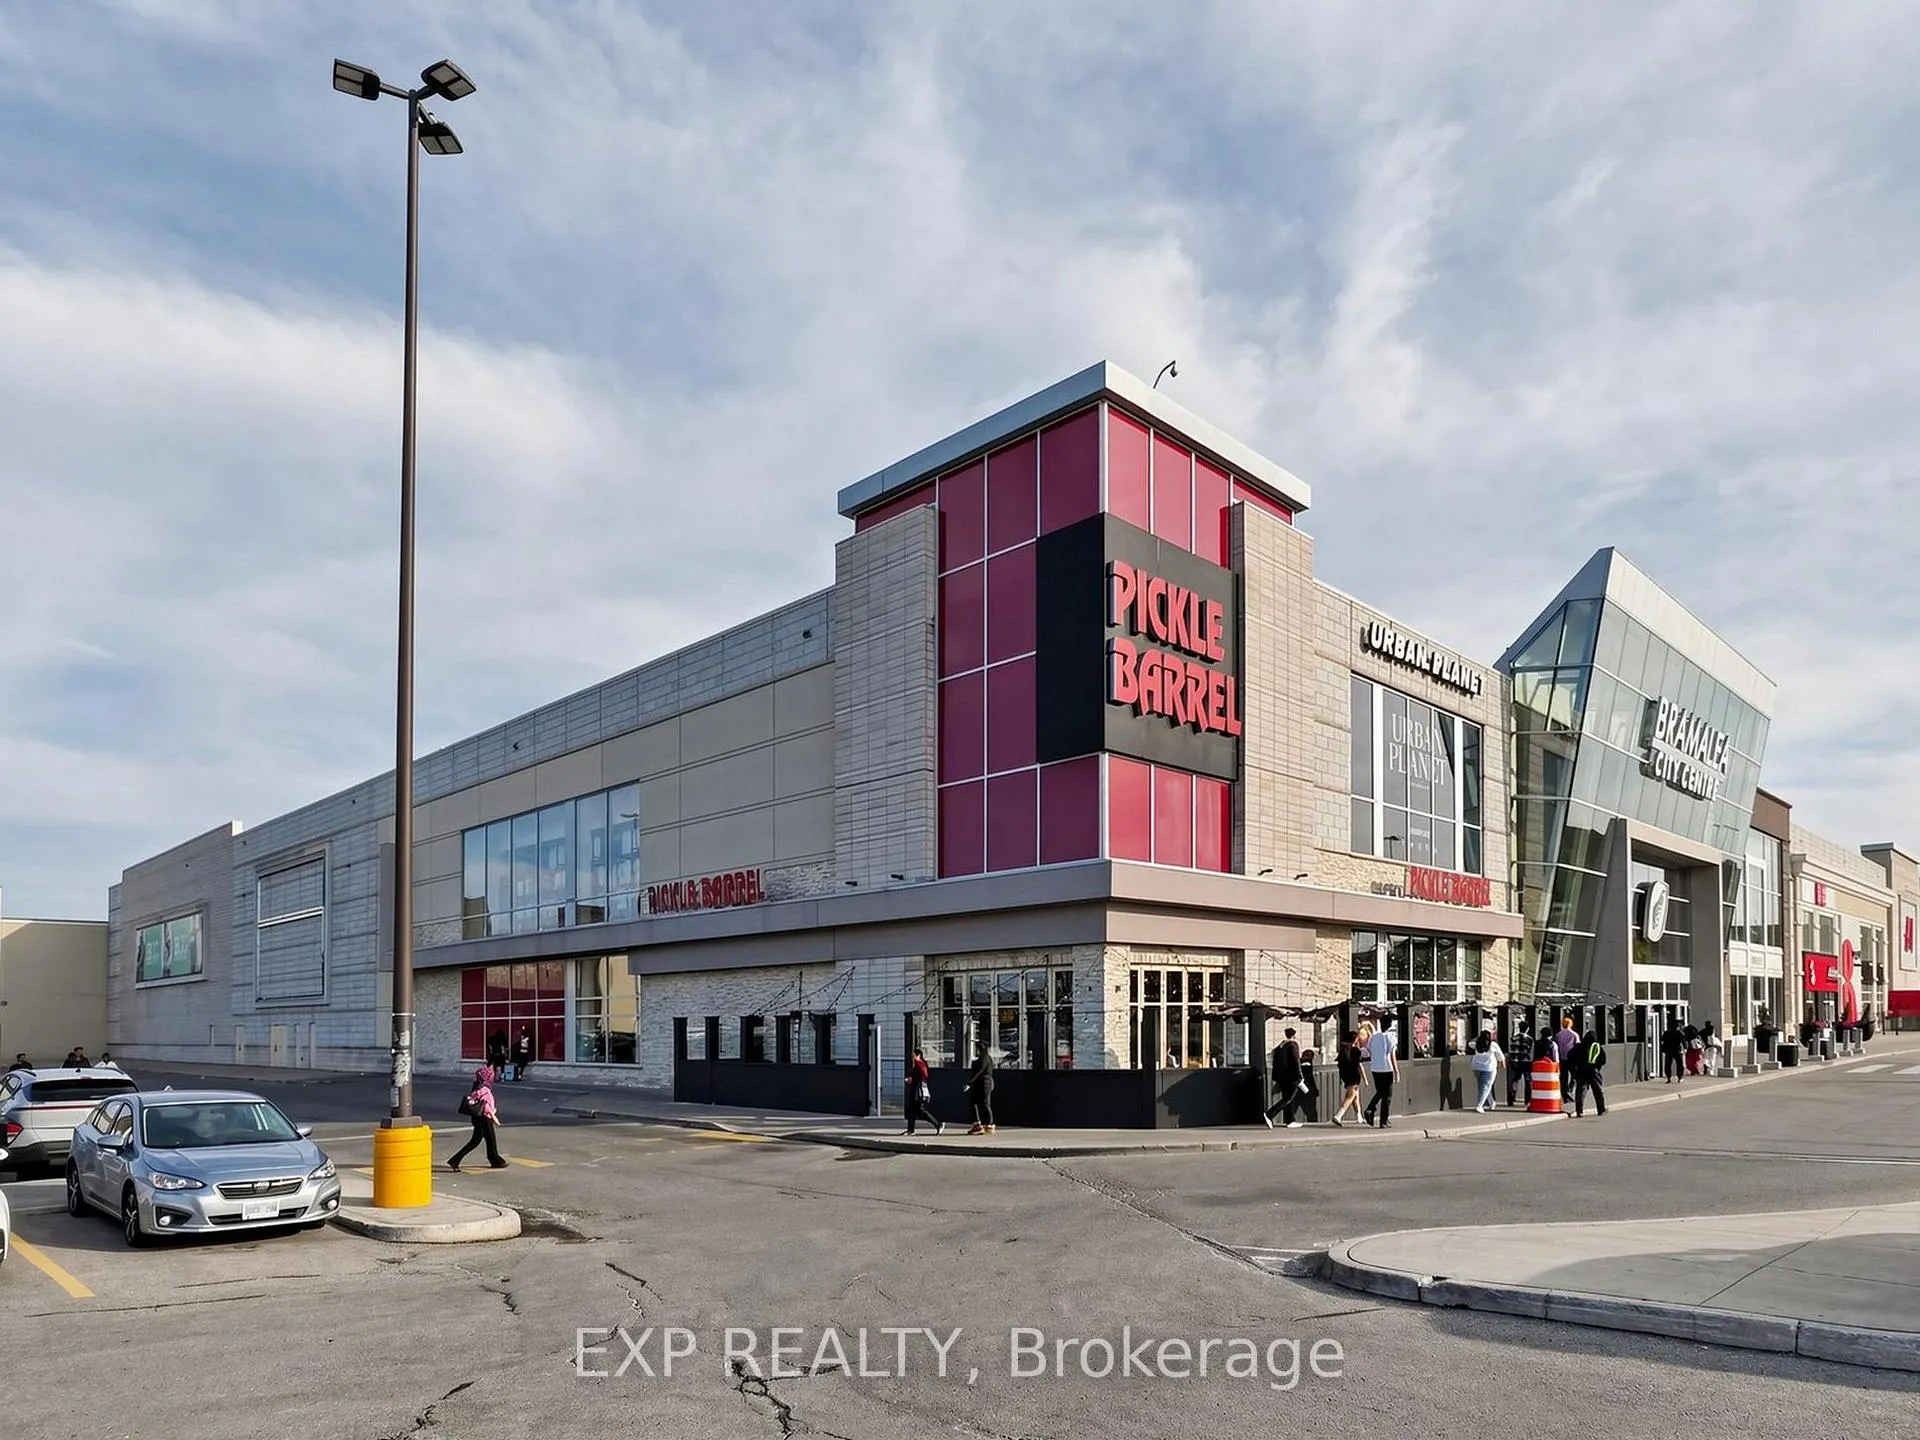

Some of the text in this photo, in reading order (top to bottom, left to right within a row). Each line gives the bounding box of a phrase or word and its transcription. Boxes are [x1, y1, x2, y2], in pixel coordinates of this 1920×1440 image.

[1107, 559, 1225, 662] PICKLE
[1107, 637, 1243, 737] BARREL
[1369, 622, 1484, 697] URBAN PLANET
[1388, 742, 1447, 786] PLANET
[1391, 713, 1447, 757] URBAN
[1655, 695, 1730, 776] BRAMALEA
[1655, 751, 1721, 803] CITY CENTRE
